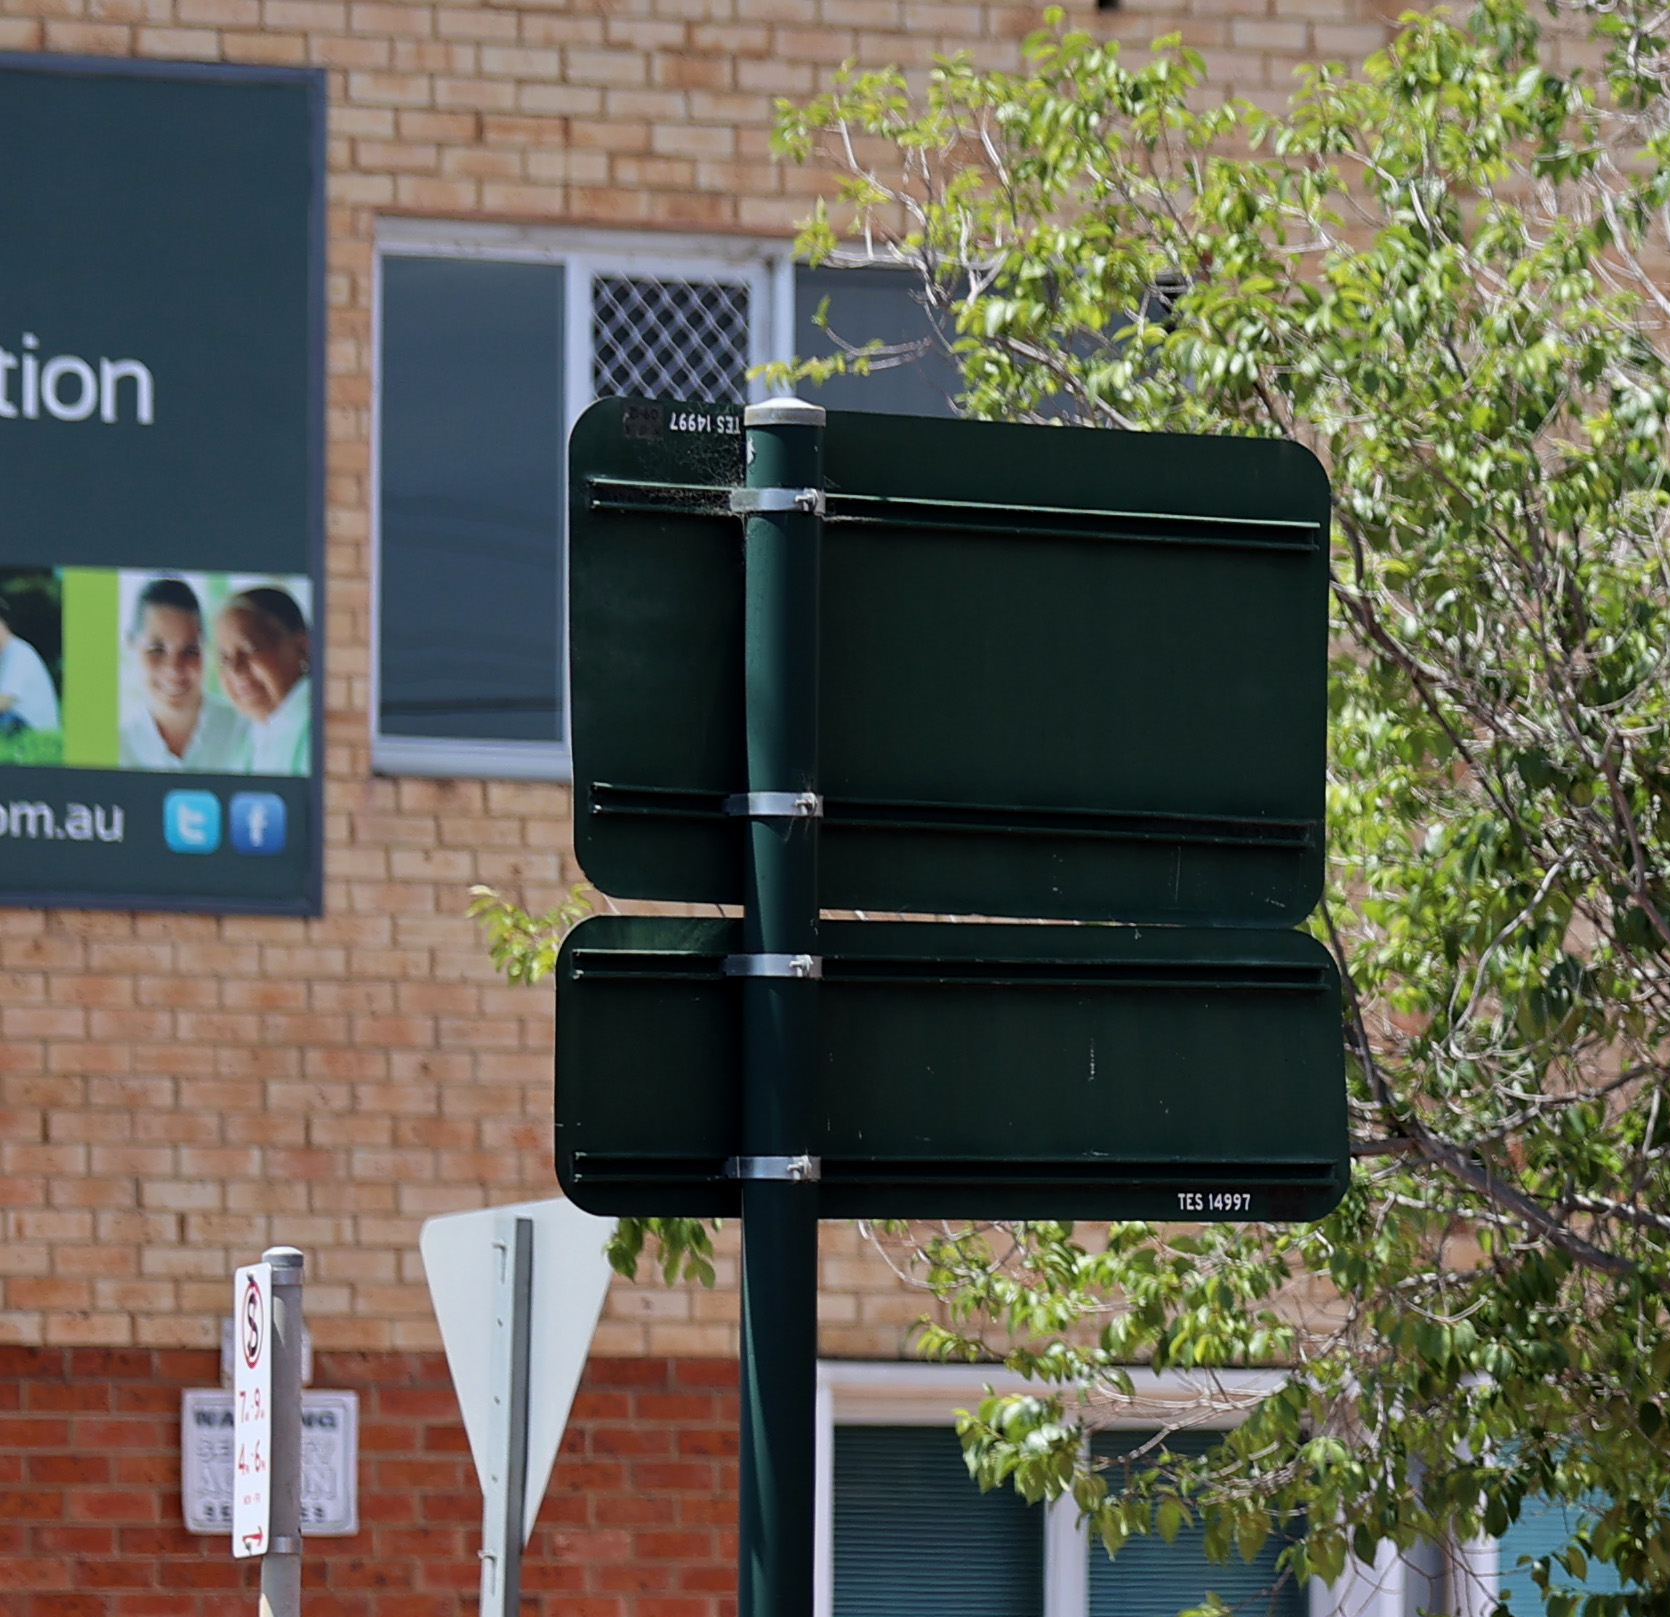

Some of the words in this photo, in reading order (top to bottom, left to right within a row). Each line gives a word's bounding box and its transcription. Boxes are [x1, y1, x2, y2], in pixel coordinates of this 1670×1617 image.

[669, 411, 711, 432] 14997
[717, 415, 741, 435] TES
[1177, 1193, 1203, 1210] TES
[1209, 1193, 1251, 1211] 14997
